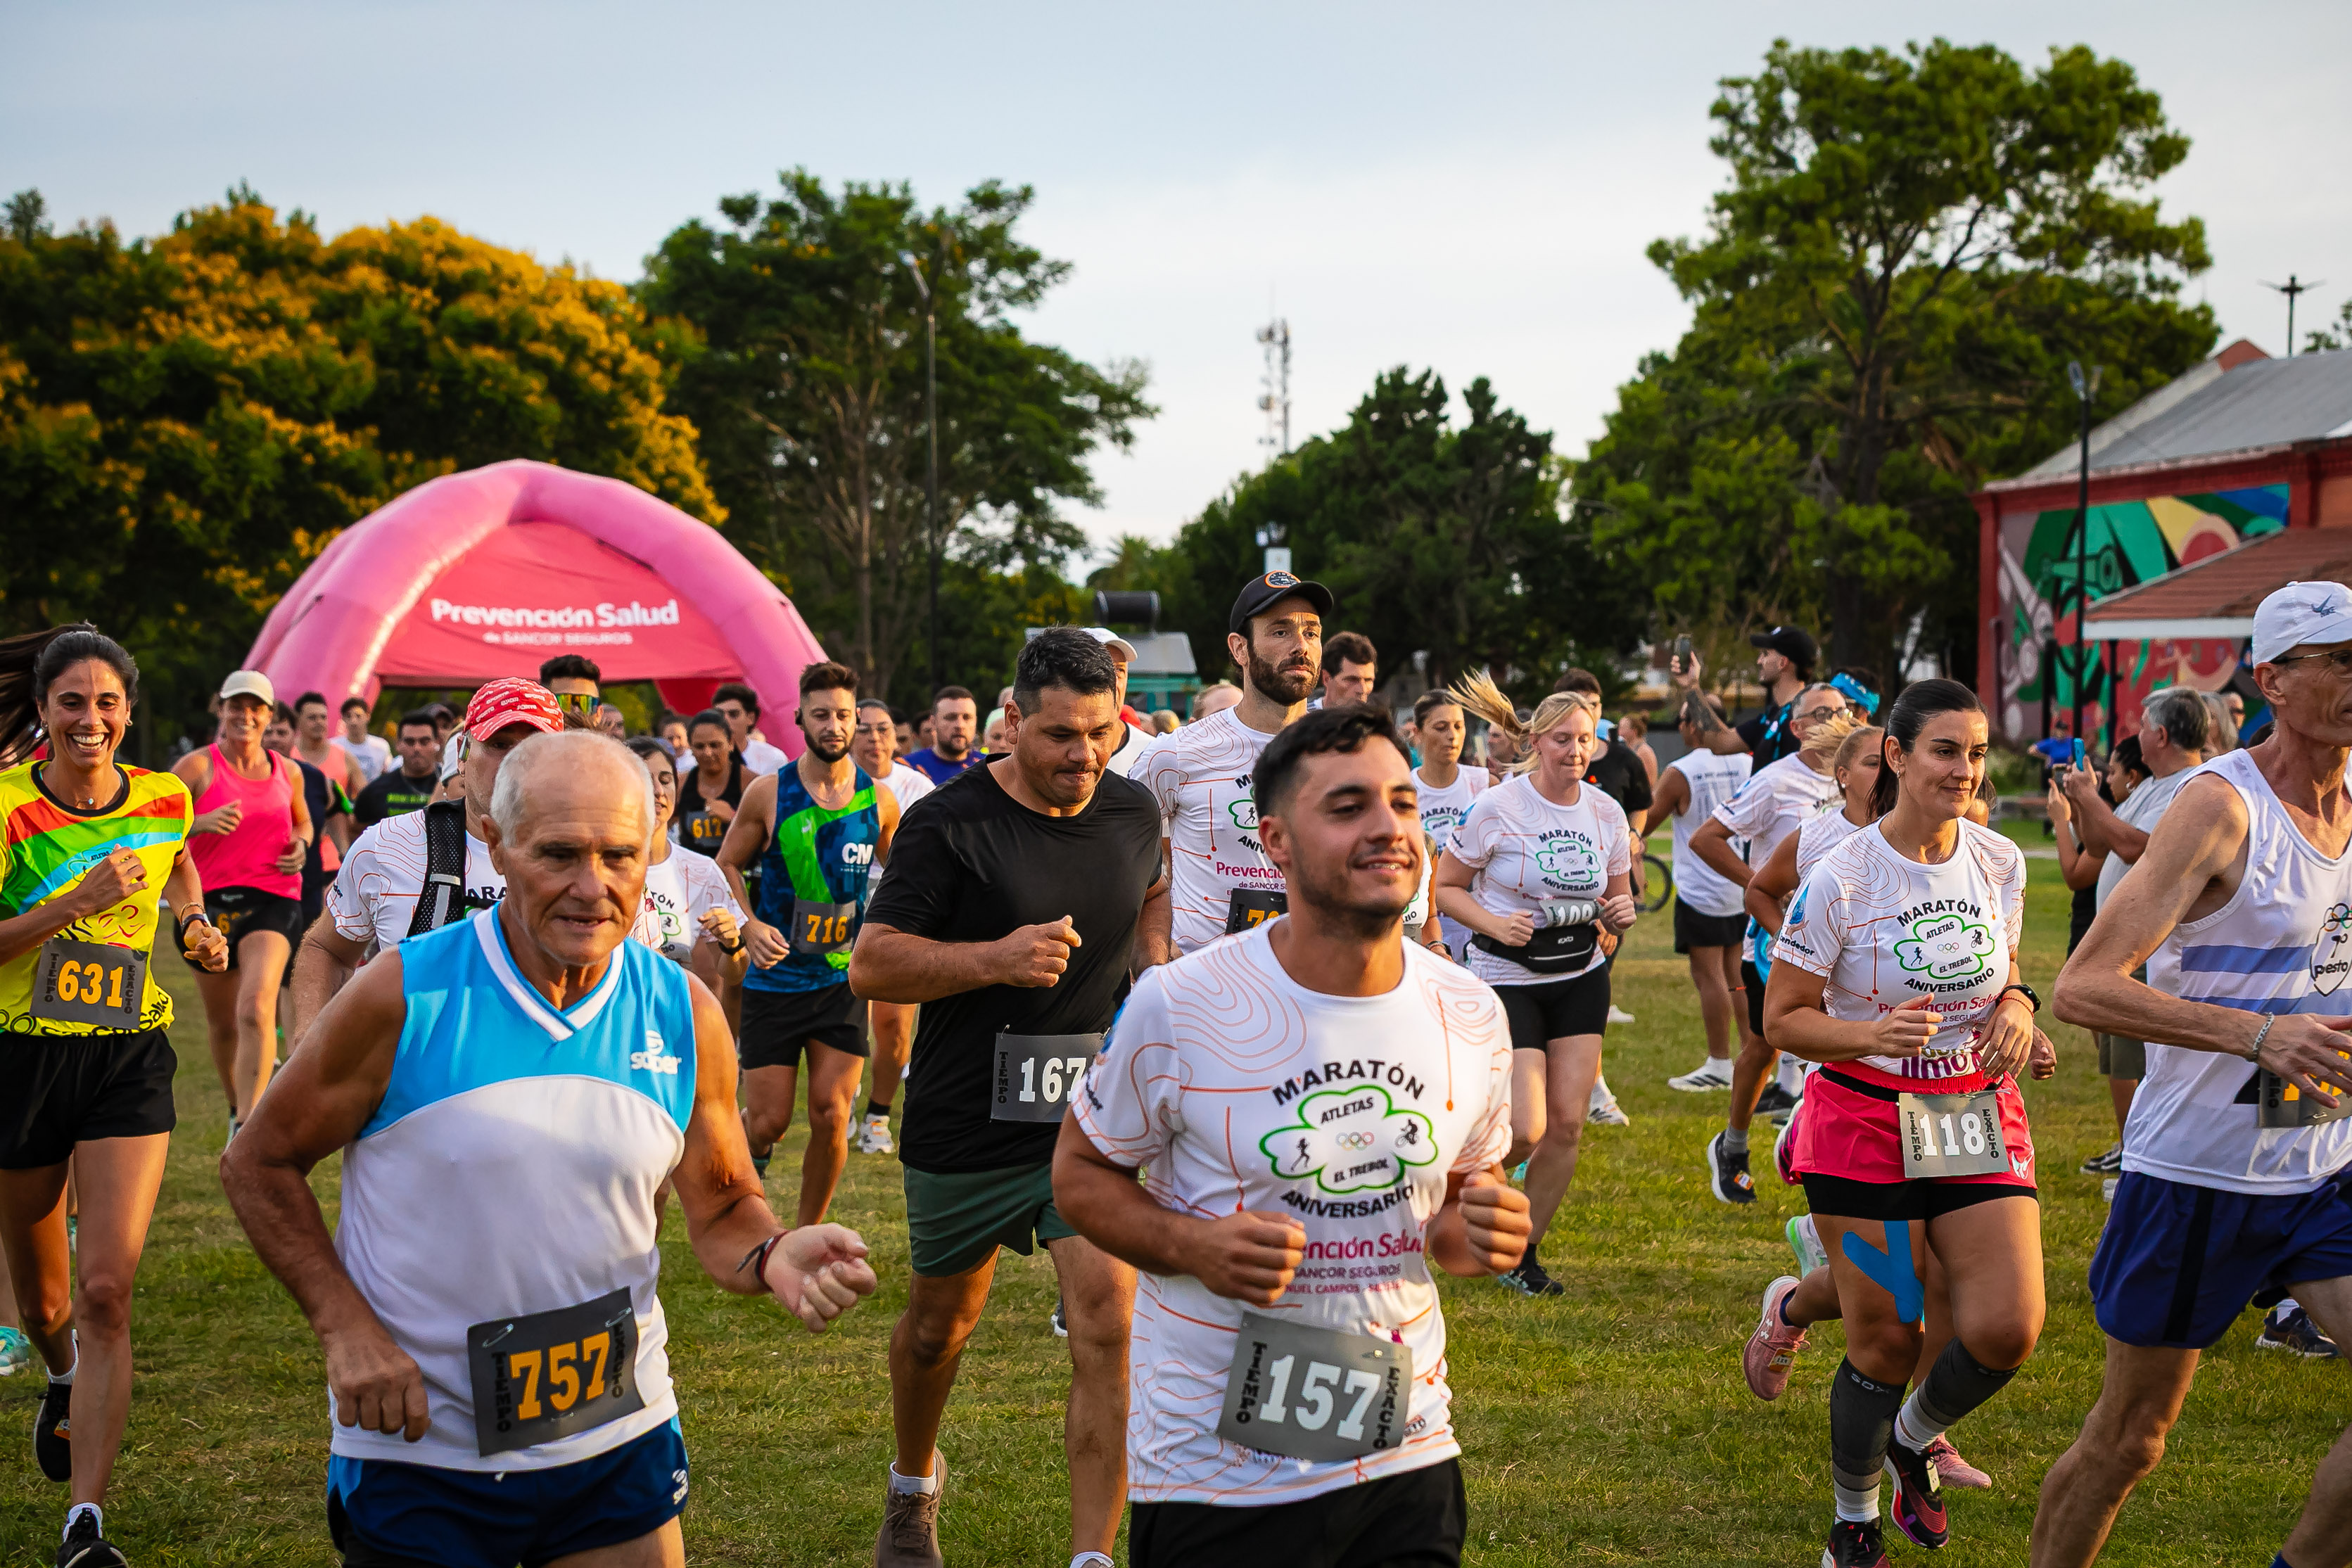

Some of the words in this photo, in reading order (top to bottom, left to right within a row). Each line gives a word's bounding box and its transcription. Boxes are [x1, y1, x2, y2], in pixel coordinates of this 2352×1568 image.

[430, 599, 595, 628] Prevención
[596, 599, 680, 627] Salud
[841, 842, 874, 865] CM
[1539, 829, 1593, 847] MARATÓN
[1216, 861, 1285, 879] Prevenci
[1541, 877, 1599, 891] ANIVERSARIO
[806, 914, 848, 943] 716
[1897, 898, 1981, 927] MARATÓN
[1926, 922, 1954, 939] ATLETAS
[44, 952, 59, 1003] TIEMPO
[1904, 968, 1995, 993] ANIVERSARIO
[1948, 956, 1973, 970] TREBOL
[58, 960, 123, 1008] 631
[124, 964, 136, 1014] EXACTO
[1879, 1000, 1967, 1014] Prnción
[998, 1052, 1009, 1104] TIEMPO
[1019, 1057, 1087, 1103] 167
[1272, 1059, 1424, 1107] MARATÓN
[1321, 1097, 1374, 1124] ATLETAS
[1907, 1111, 1923, 1161] TIEMPO
[1919, 1113, 1985, 1156] 118
[1982, 1109, 2000, 1159] EXACTO
[1333, 1171, 1347, 1184] EL
[1349, 1157, 1390, 1178] TREBOL
[1279, 1185, 1414, 1219] ANIVERSARIO
[1304, 1236, 1373, 1260] nción
[509, 1331, 610, 1420] 757
[611, 1322, 625, 1398] EXACTO
[491, 1351, 511, 1432] TIEMPO
[1236, 1341, 1267, 1424] TIEMPO
[1259, 1354, 1381, 1441] 157
[1373, 1366, 1401, 1449] EXACTO
